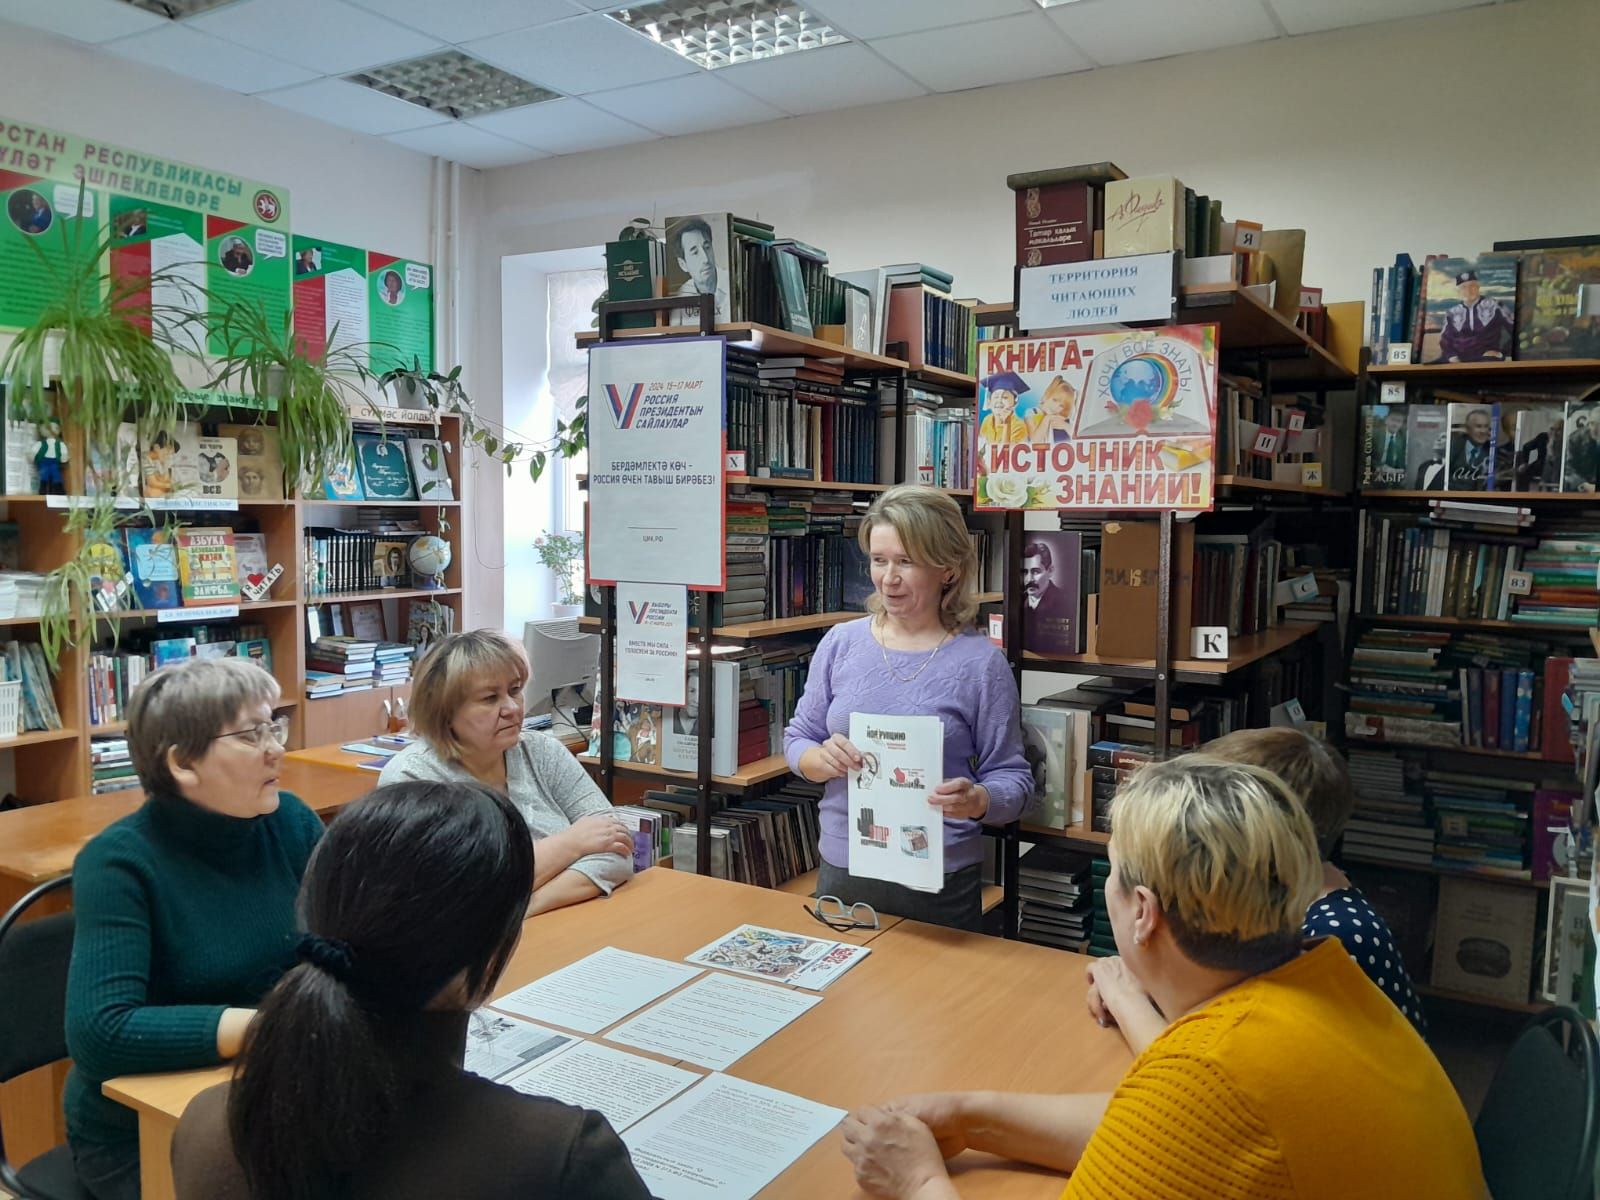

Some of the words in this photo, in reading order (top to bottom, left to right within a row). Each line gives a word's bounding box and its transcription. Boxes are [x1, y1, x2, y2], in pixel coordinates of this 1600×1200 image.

[83, 143, 243, 197] РЕСПУБЛИКАСЫ
[1243, 233, 1254, 246] Я
[1049, 266, 1138, 284] ТЕРРИТОРИЯ
[1051, 286, 1137, 303] ЧИТАЮЩИХ
[1066, 304, 1119, 320] ЛЮДЕЙ
[988, 339, 1094, 374] КНИГА-
[1393, 350, 1407, 360] 85
[1098, 353, 1120, 398] ХОЧУ
[649, 382, 664, 392] 2024
[684, 380, 704, 390] МАРТ
[1388, 388, 1400, 396] 85
[643, 394, 680, 405] РОССИЯ
[639, 405, 704, 418] ПРЕЗИДЕНТЫН
[636, 417, 689, 430] САЙЛАУЛАР
[991, 440, 1166, 473] ИСТОЧНИК
[610, 461, 668, 472] БЕРДӘМЛЕКТӘ
[669, 461, 687, 472] КӨЧ
[593, 474, 620, 485] РОССИЯ
[622, 474, 643, 485] ӨЧЕН
[644, 474, 674, 485] ТАВЫШ
[676, 474, 715, 485] БИРӘБЕЗ!
[190, 535, 225, 545] АЗБУКА
[253, 566, 282, 596] ЧИТАТЬ
[1510, 578, 1526, 588] 83
[1203, 633, 1222, 653] К
